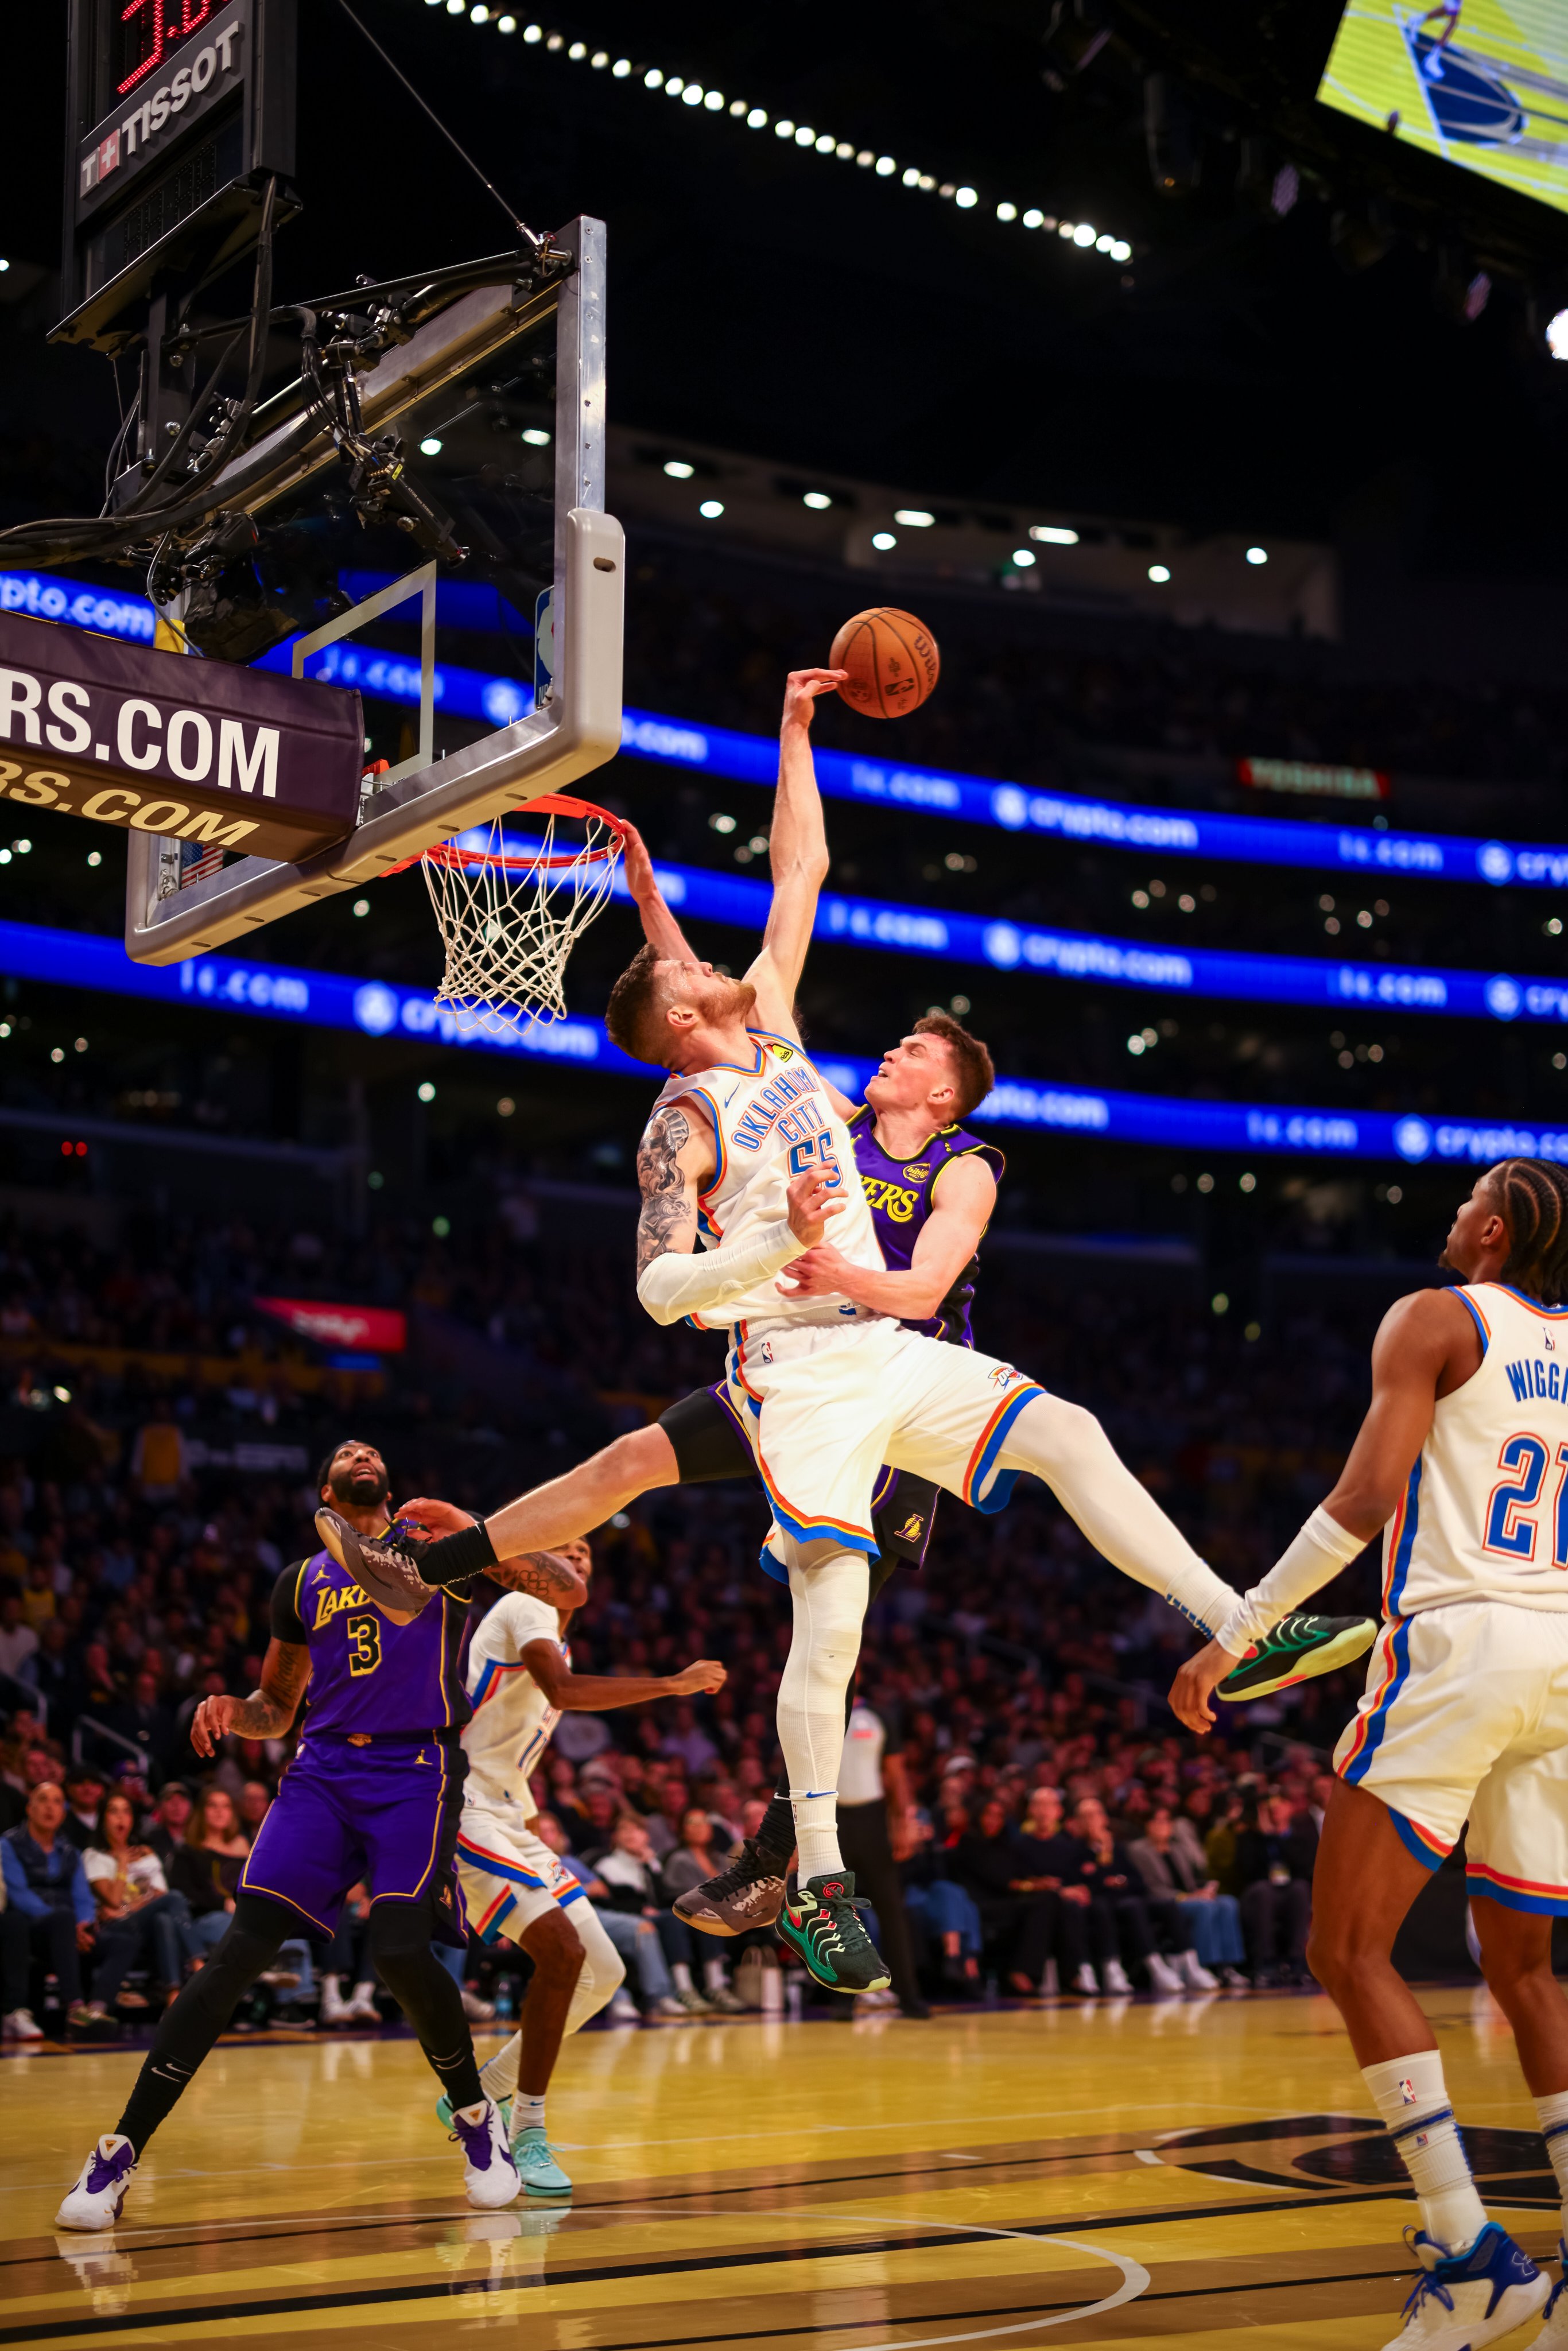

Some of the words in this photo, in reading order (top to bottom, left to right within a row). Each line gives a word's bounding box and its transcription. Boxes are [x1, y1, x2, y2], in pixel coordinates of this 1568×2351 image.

[122, 20, 239, 157] TISSOT
[0, 668, 280, 798] RS.COM
[731, 1066, 821, 1153] OKLAHOM
[775, 1097, 825, 1145] CITY
[906, 1166, 929, 1179] bibigo
[347, 1614, 382, 1677] 3
